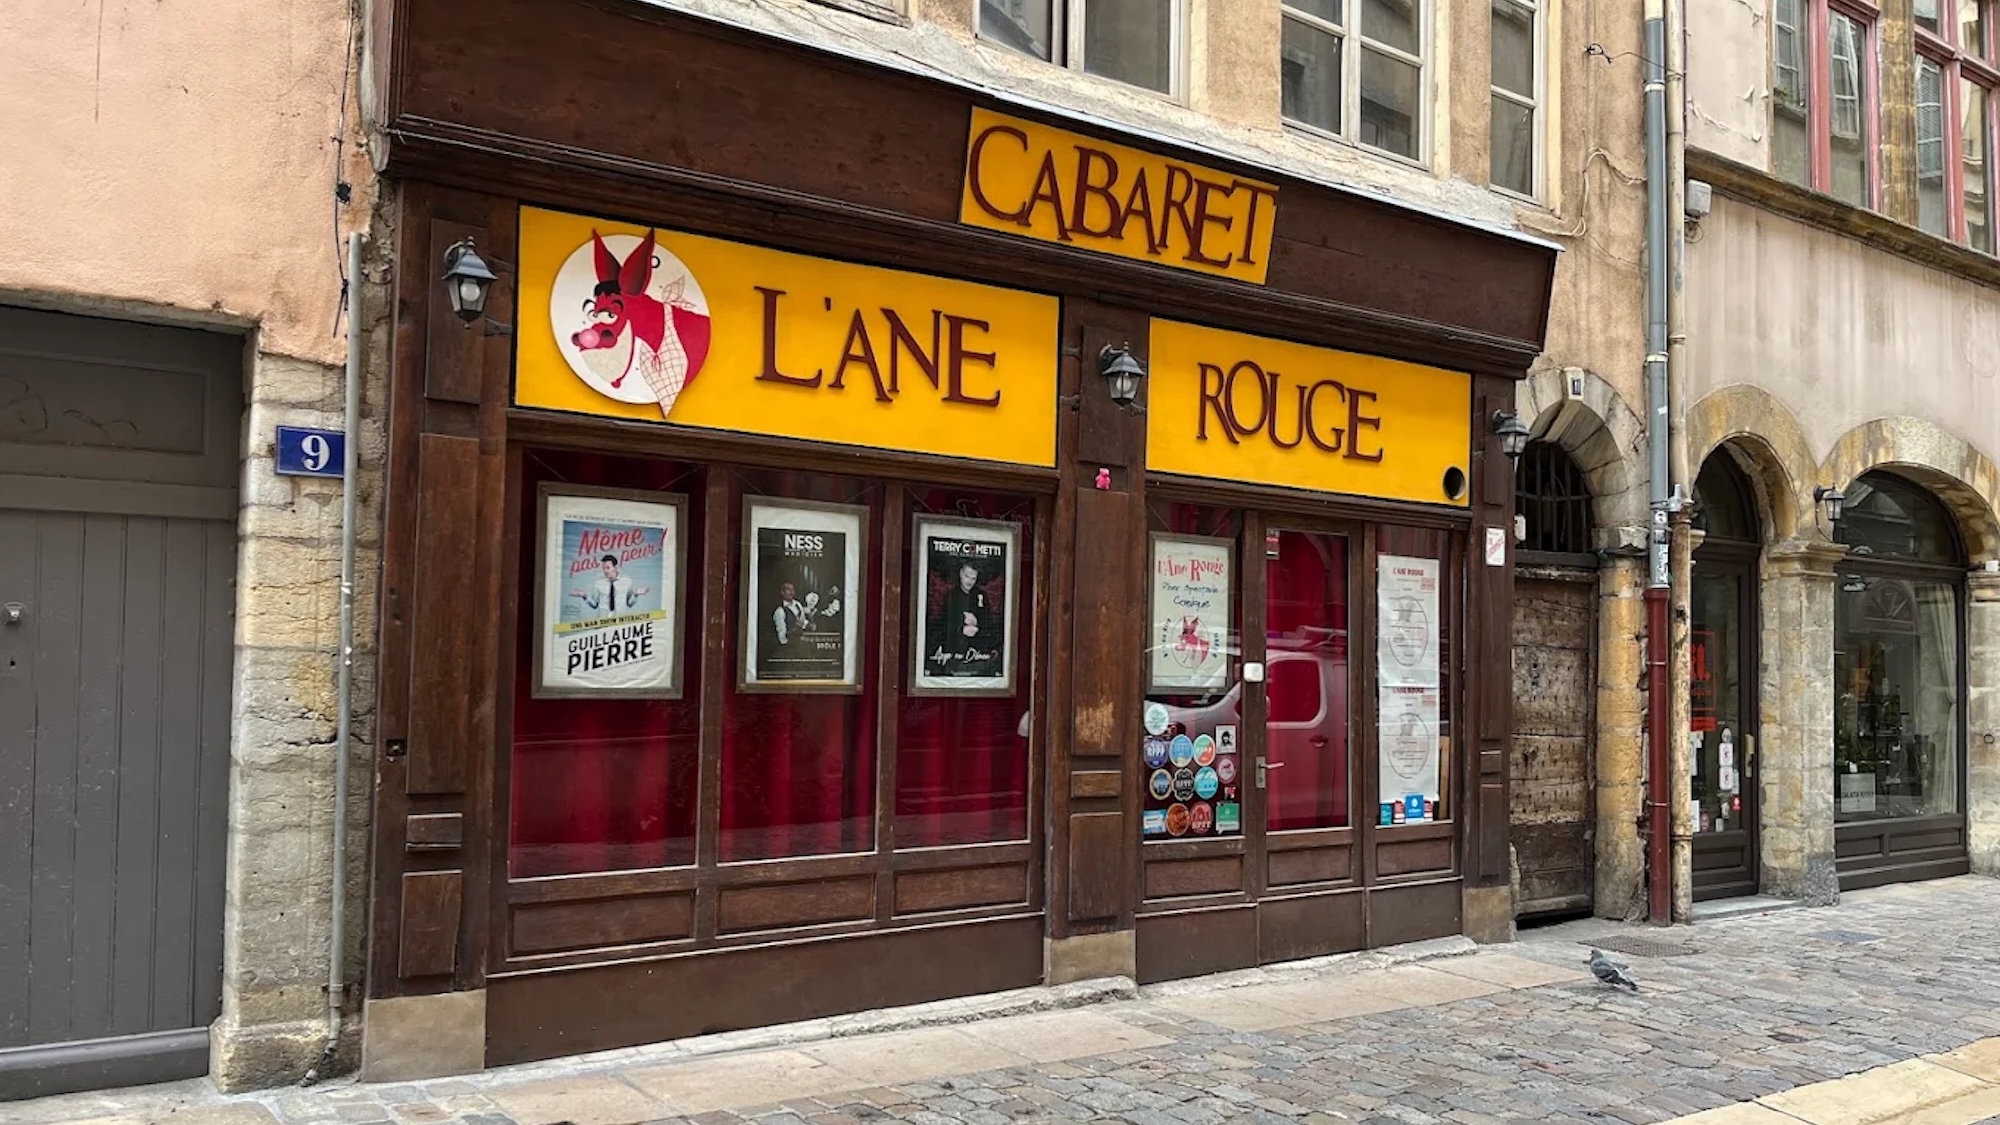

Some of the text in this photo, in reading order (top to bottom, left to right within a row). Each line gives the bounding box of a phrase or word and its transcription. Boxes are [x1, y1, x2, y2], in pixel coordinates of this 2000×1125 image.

[969, 125, 1277, 268] CABARET
[754, 286, 1384, 463] L'ANE ROUGE
[301, 435, 330, 471] 9
[578, 527, 645, 556] Même
[784, 534, 823, 550] NESS
[933, 540, 962, 552] TERRY
[570, 556, 601, 578] pas
[1188, 557, 1225, 582] Rouge
[568, 621, 653, 653] GUILLAUME
[567, 635, 653, 675] PIERRE
